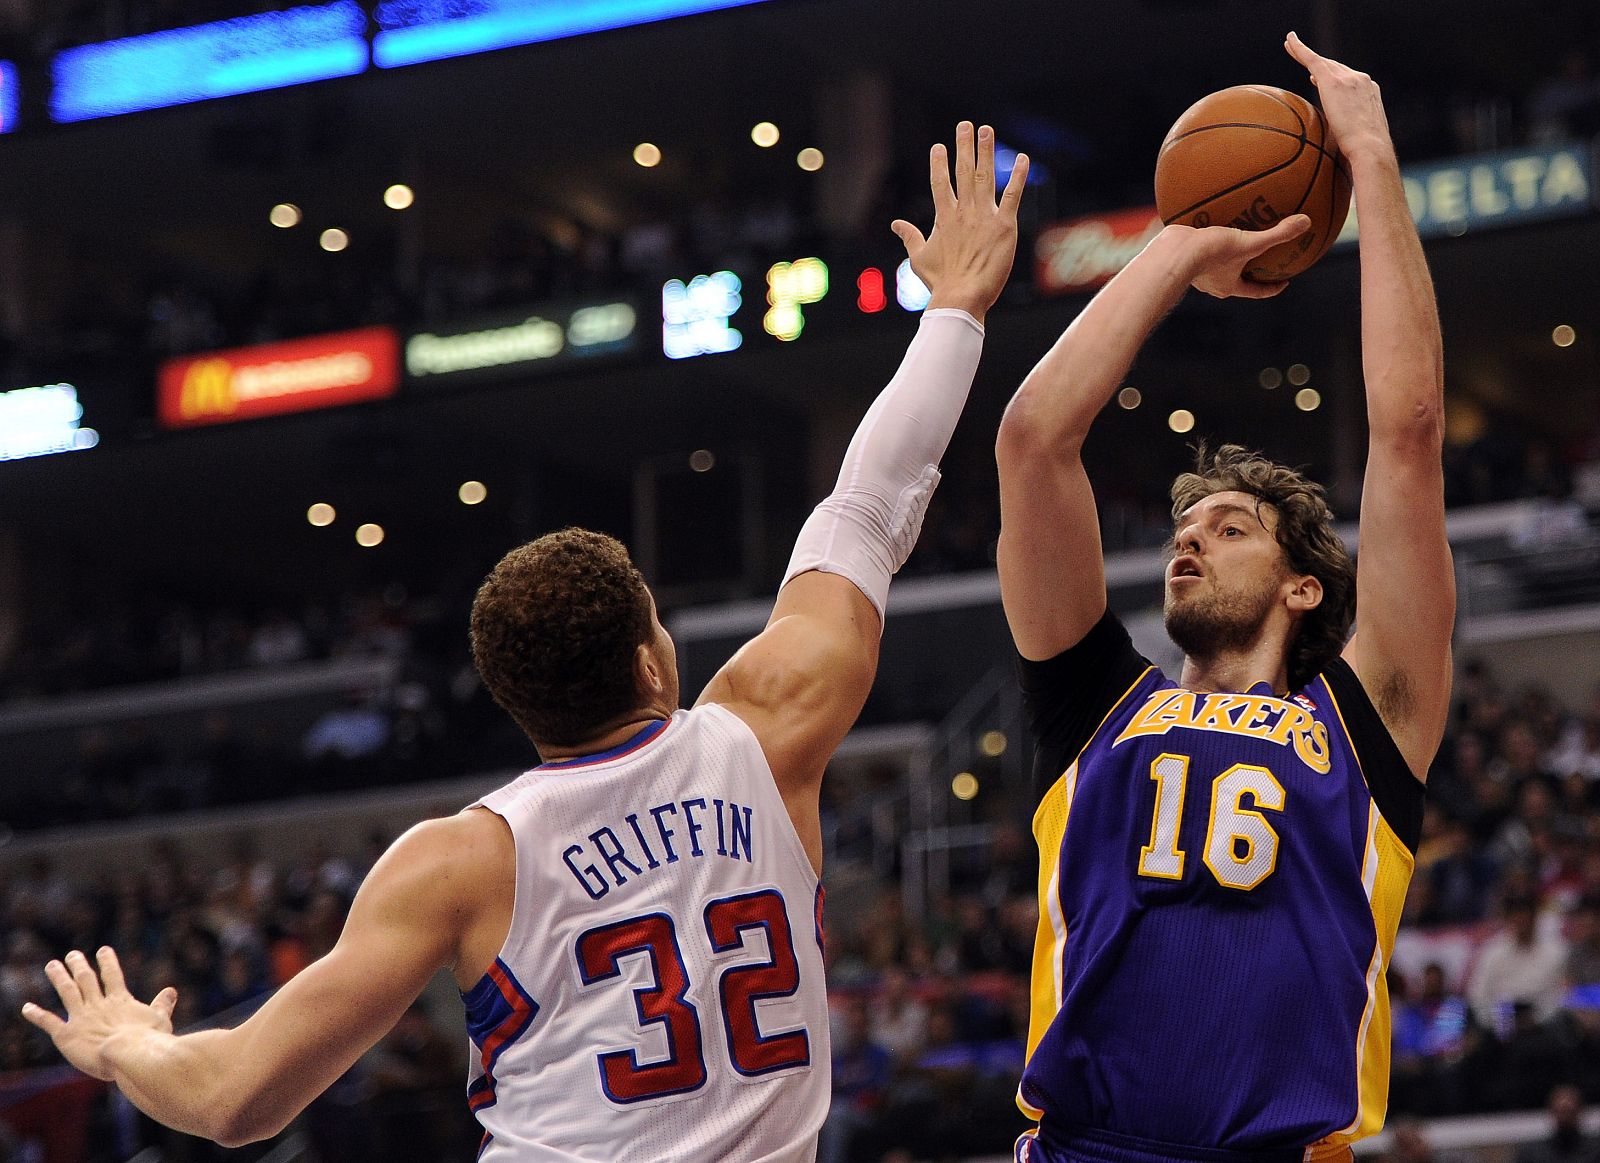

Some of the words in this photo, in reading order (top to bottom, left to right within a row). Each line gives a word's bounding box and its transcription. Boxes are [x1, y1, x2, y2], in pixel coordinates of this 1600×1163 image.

[1112, 688, 1331, 774] LAKERS
[562, 797, 753, 901] GRIFFIN
[1137, 752, 1287, 891] 16
[573, 887, 811, 1105] 32
